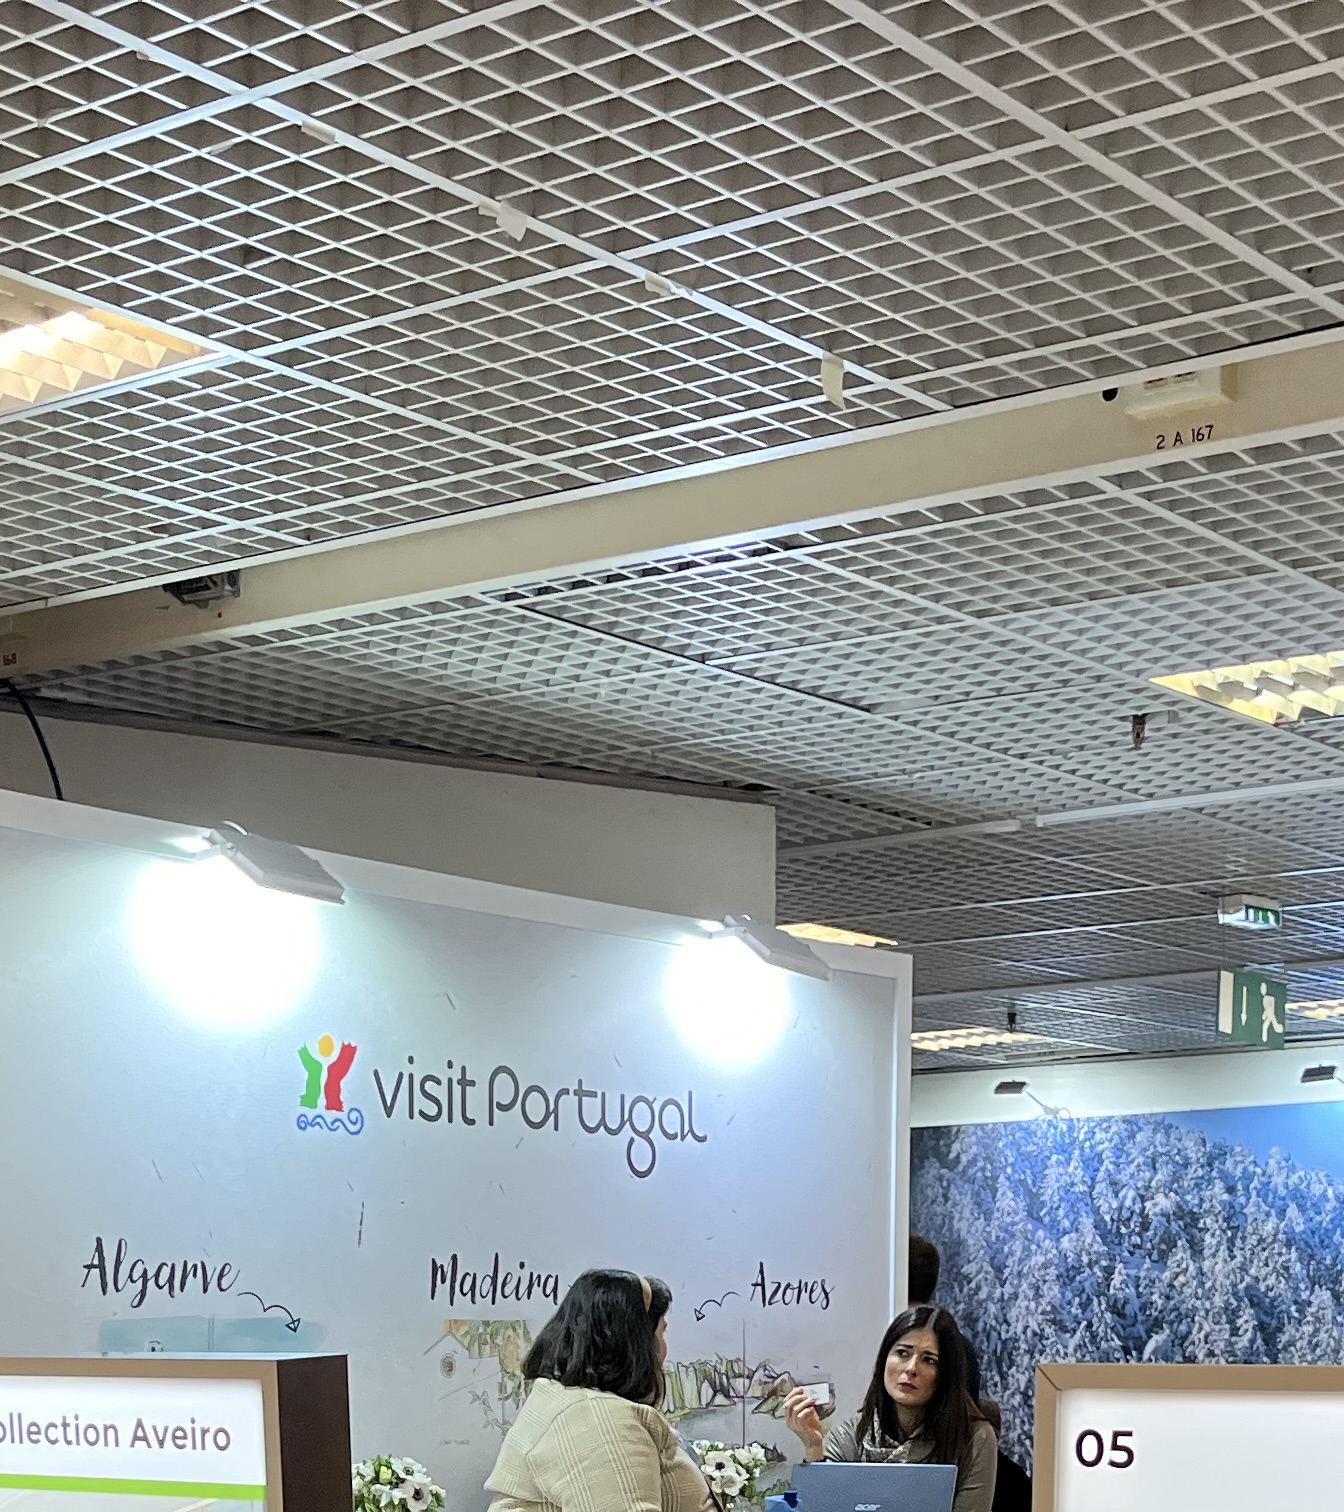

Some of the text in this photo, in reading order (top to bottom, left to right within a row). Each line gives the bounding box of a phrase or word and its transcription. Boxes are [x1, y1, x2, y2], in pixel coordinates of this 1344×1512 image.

[1156, 424, 1214, 450] 2 A 167
[81, 1236, 240, 1309] Algarve
[430, 1252, 560, 1306] Madeira
[750, 1261, 837, 1311] Azores
[129, 1416, 231, 1452] Aveiro
[1074, 1429, 1136, 1470] 05
